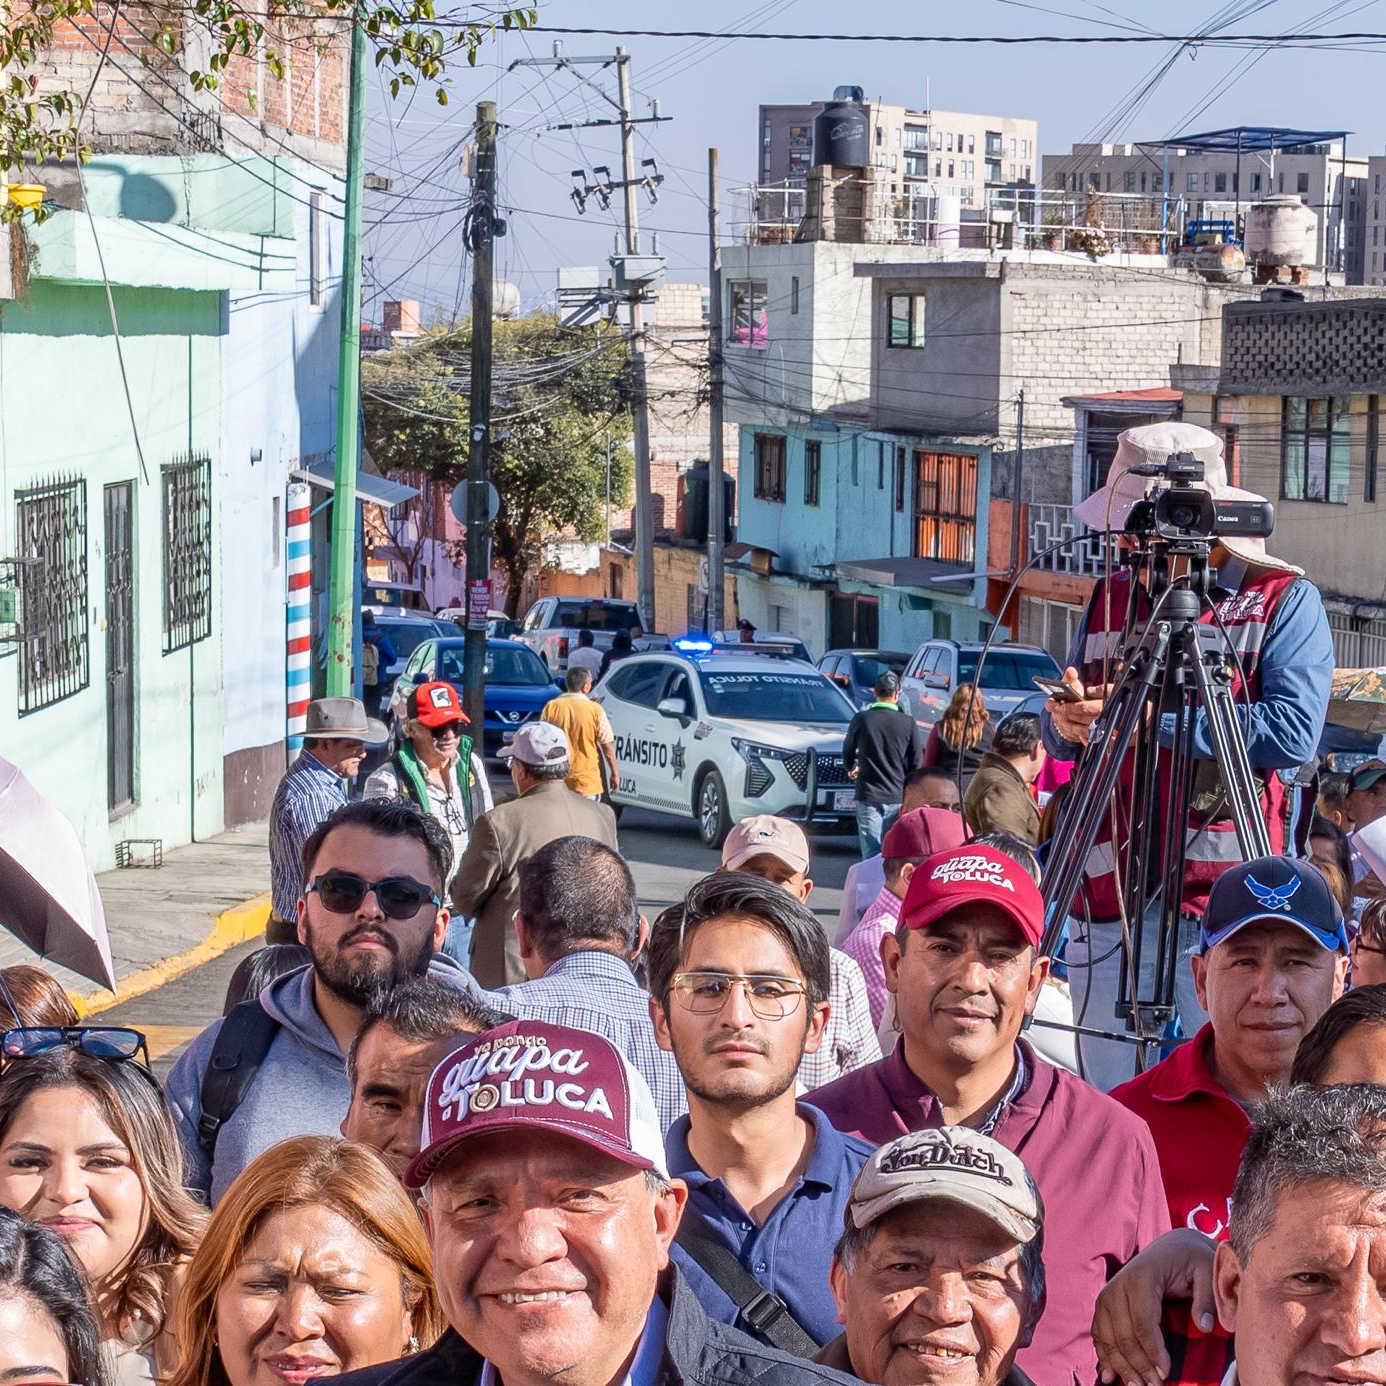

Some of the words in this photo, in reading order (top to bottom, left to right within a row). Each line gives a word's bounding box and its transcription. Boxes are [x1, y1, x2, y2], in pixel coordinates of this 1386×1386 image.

[942, 871, 1015, 892] TOLUCA
[439, 1045, 590, 1106] guapa
[453, 1078, 614, 1122] TOLUCA
